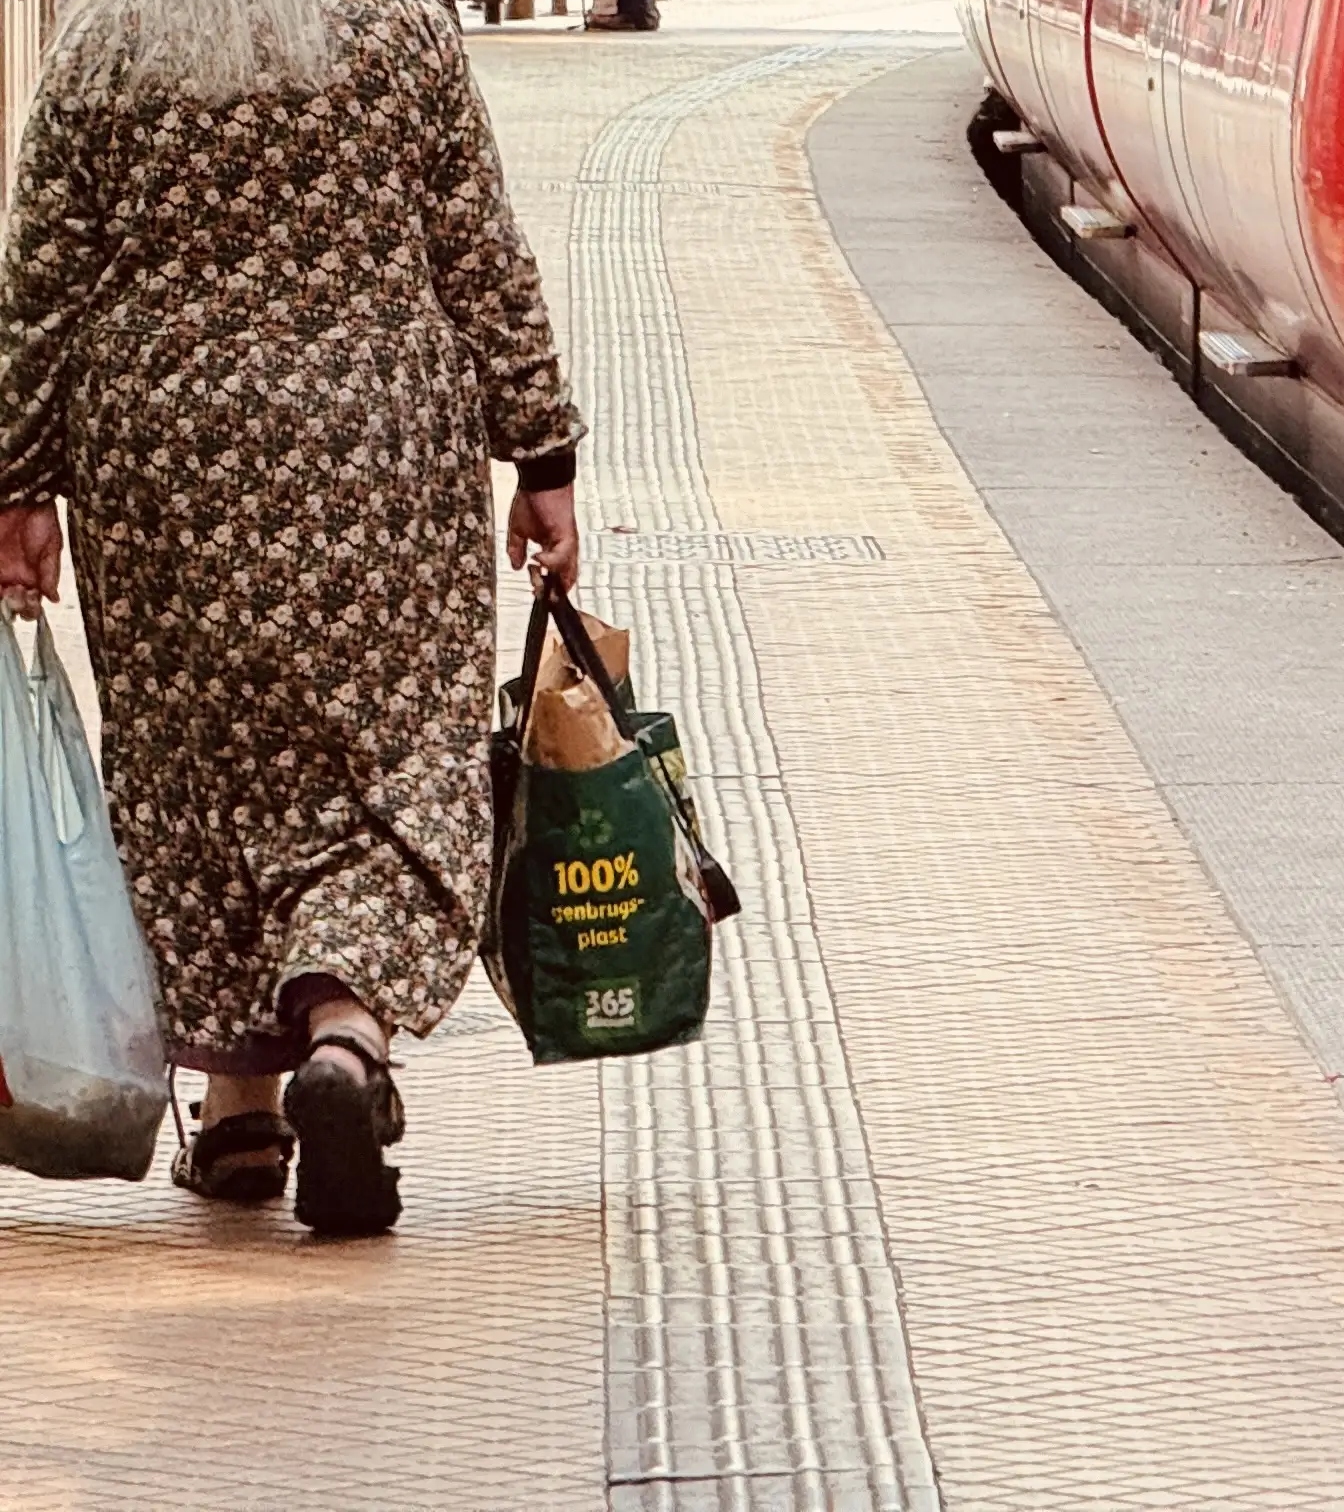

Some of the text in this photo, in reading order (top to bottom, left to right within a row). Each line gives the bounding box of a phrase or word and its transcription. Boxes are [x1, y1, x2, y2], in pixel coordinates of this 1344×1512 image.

[553, 851, 640, 895] 100%
[577, 925, 629, 952] plast
[584, 987, 635, 1018] 365
